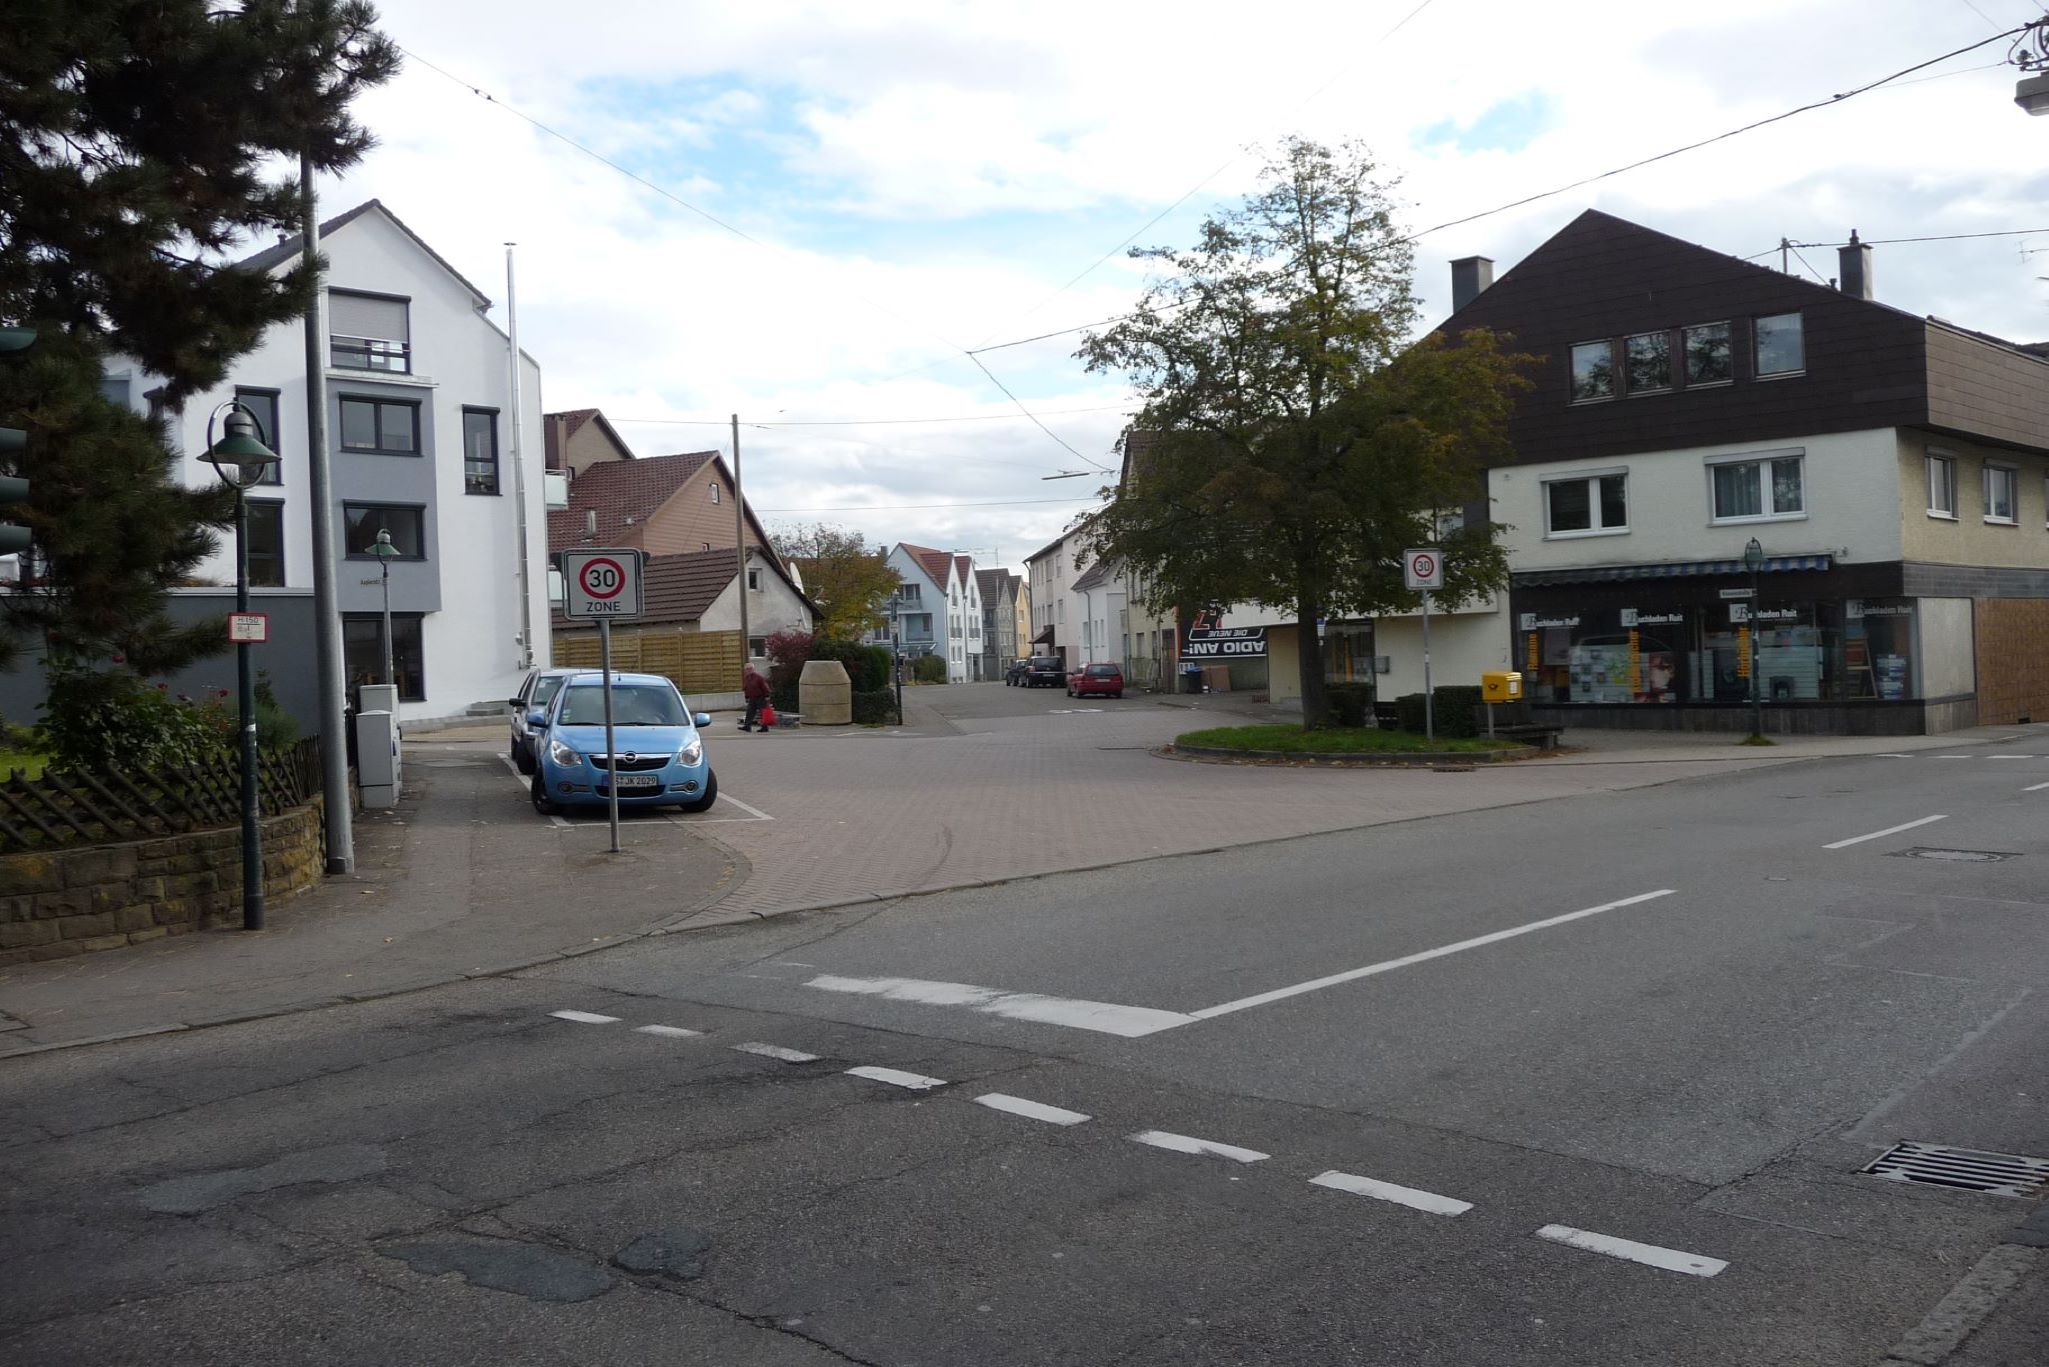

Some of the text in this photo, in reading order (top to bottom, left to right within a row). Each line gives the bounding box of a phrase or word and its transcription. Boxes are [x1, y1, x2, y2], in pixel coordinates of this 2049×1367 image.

[1417, 560, 1430, 571] 30
[589, 569, 616, 588] 30
[586, 601, 621, 612] ZONE
[1207, 629, 1248, 638] DIE NEUE
[1189, 641, 1266, 654] ADIO AN!
